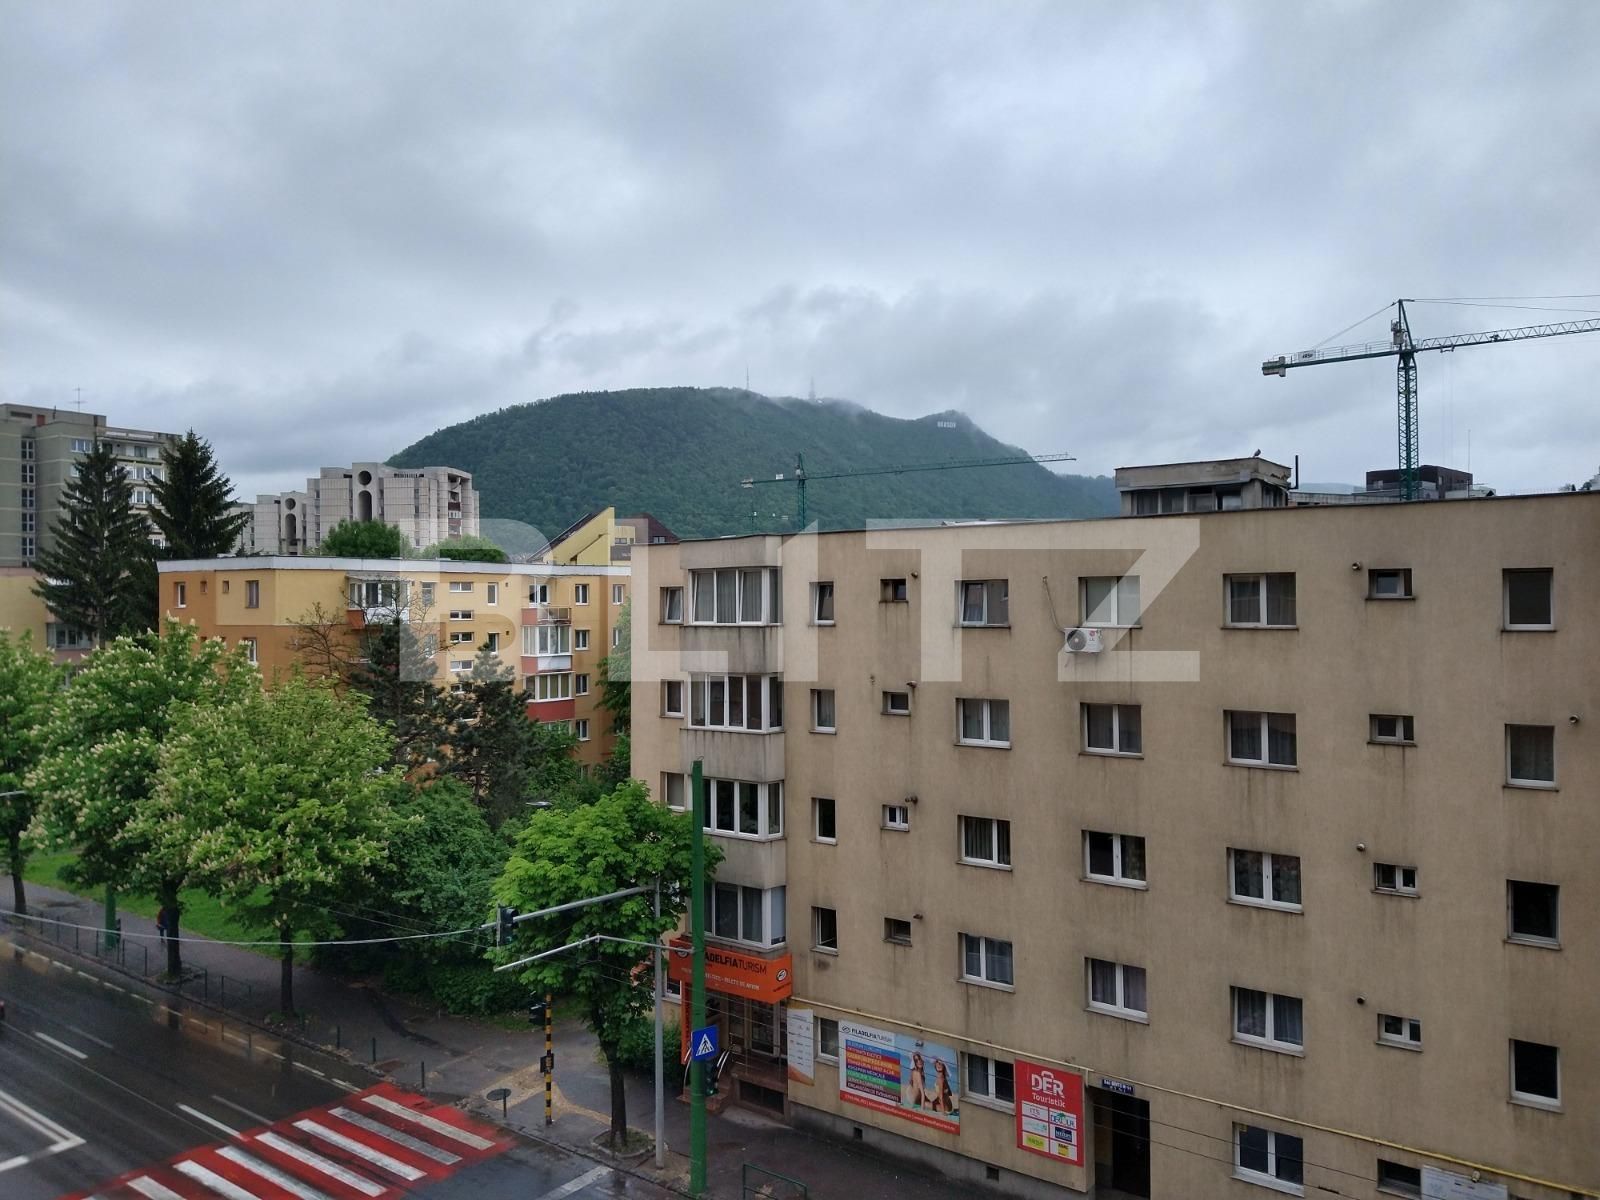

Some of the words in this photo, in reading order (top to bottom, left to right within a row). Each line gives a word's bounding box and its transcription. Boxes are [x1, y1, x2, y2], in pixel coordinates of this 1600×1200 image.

[705, 951, 767, 975] ADELFIATURISM
[1031, 1072, 1065, 1098] DER
[1032, 1092, 1066, 1108] Touristik
